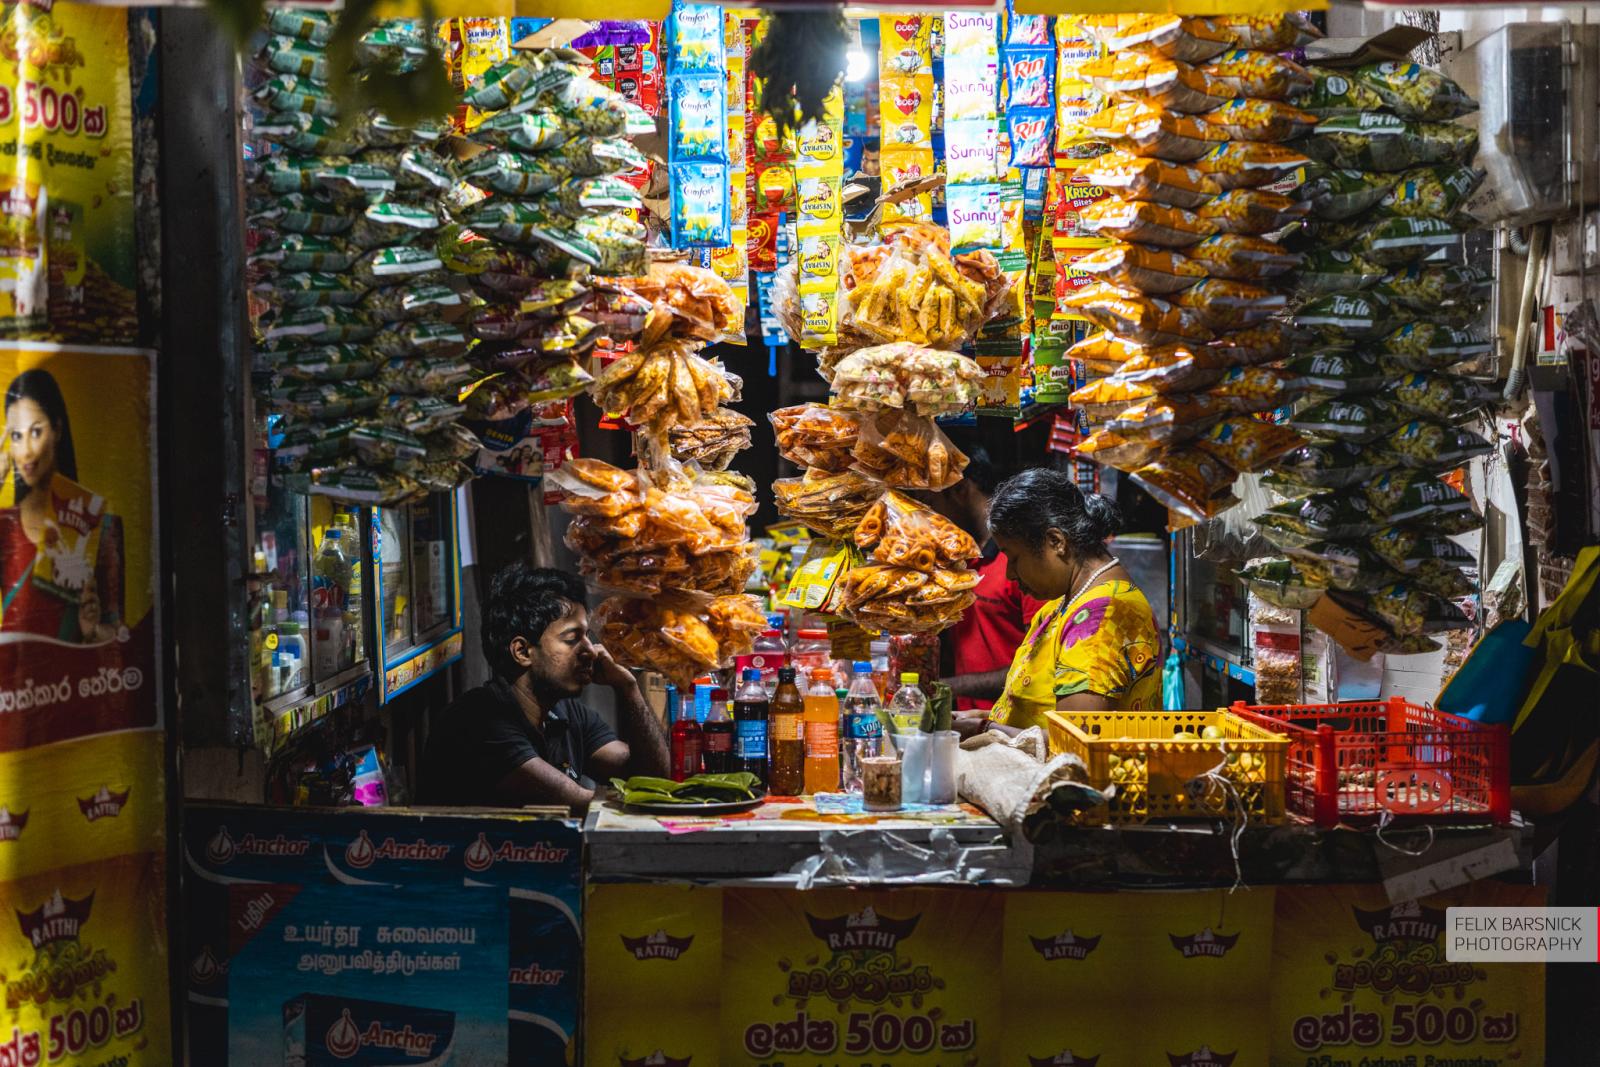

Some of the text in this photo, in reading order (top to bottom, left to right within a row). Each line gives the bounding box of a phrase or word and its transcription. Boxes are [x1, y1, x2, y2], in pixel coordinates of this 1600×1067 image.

[678, 11, 711, 24] Comfort
[949, 13, 994, 30] Sunny
[466, 28, 502, 40] Sunlight
[1014, 56, 1045, 78] Rin
[950, 80, 994, 97] Sunny
[680, 96, 712, 111] Comfort
[1016, 120, 1045, 140] Rin
[950, 144, 994, 162] Sunny
[683, 185, 715, 200] Comfort
[1064, 185, 1104, 203] KRISCO
[1073, 199, 1093, 208] Bites
[953, 209, 996, 225] Sunny
[1073, 277, 1092, 286] Bites
[86, 802, 120, 820] RATTHI
[238, 833, 310, 855] Anchor
[375, 838, 449, 861] Anchor
[496, 840, 568, 863] Anchor
[32, 918, 78, 948] RATTHI
[284, 920, 475, 948] உயர்தர சுவையை
[829, 930, 896, 949] RATTHI
[1373, 920, 1438, 942] RATTHI
[635, 944, 679, 959] RATTHI
[1044, 943, 1087, 959] RATTHI
[1183, 942, 1225, 957] RATTHI
[297, 949, 461, 976] அனுபவித்திடுங்கள்
[509, 963, 564, 986] nchor
[361, 1020, 437, 1051] Anchor
